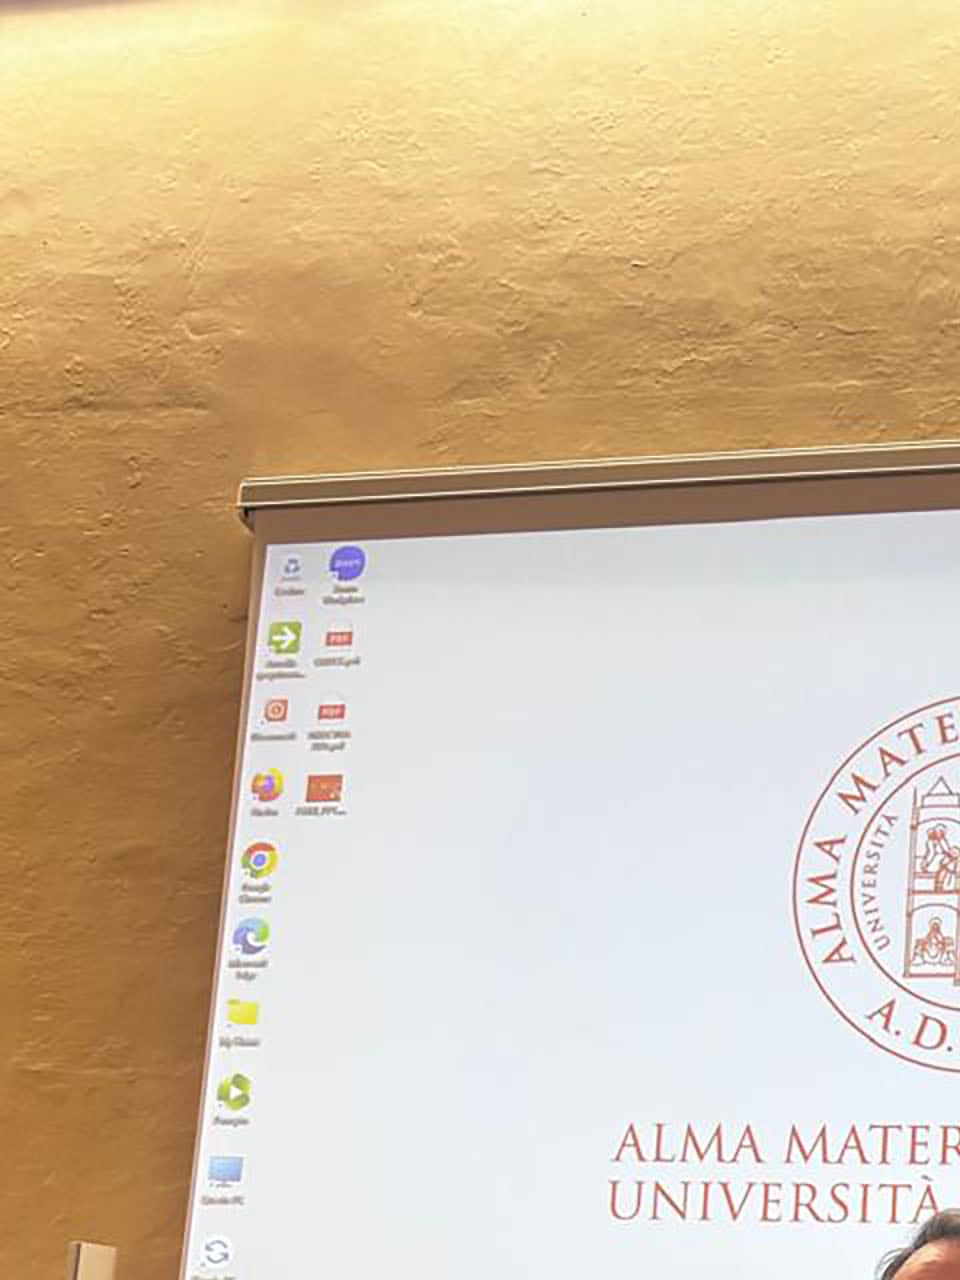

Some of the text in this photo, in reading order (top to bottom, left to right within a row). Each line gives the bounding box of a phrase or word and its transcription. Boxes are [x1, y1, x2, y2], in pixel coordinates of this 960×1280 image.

[807, 833, 857, 967] ALMA
[860, 812, 899, 952] UNIVERSITÀ
[610, 1122, 765, 1164] ALMA
[608, 1174, 943, 1224] UNIVERSITÀ
